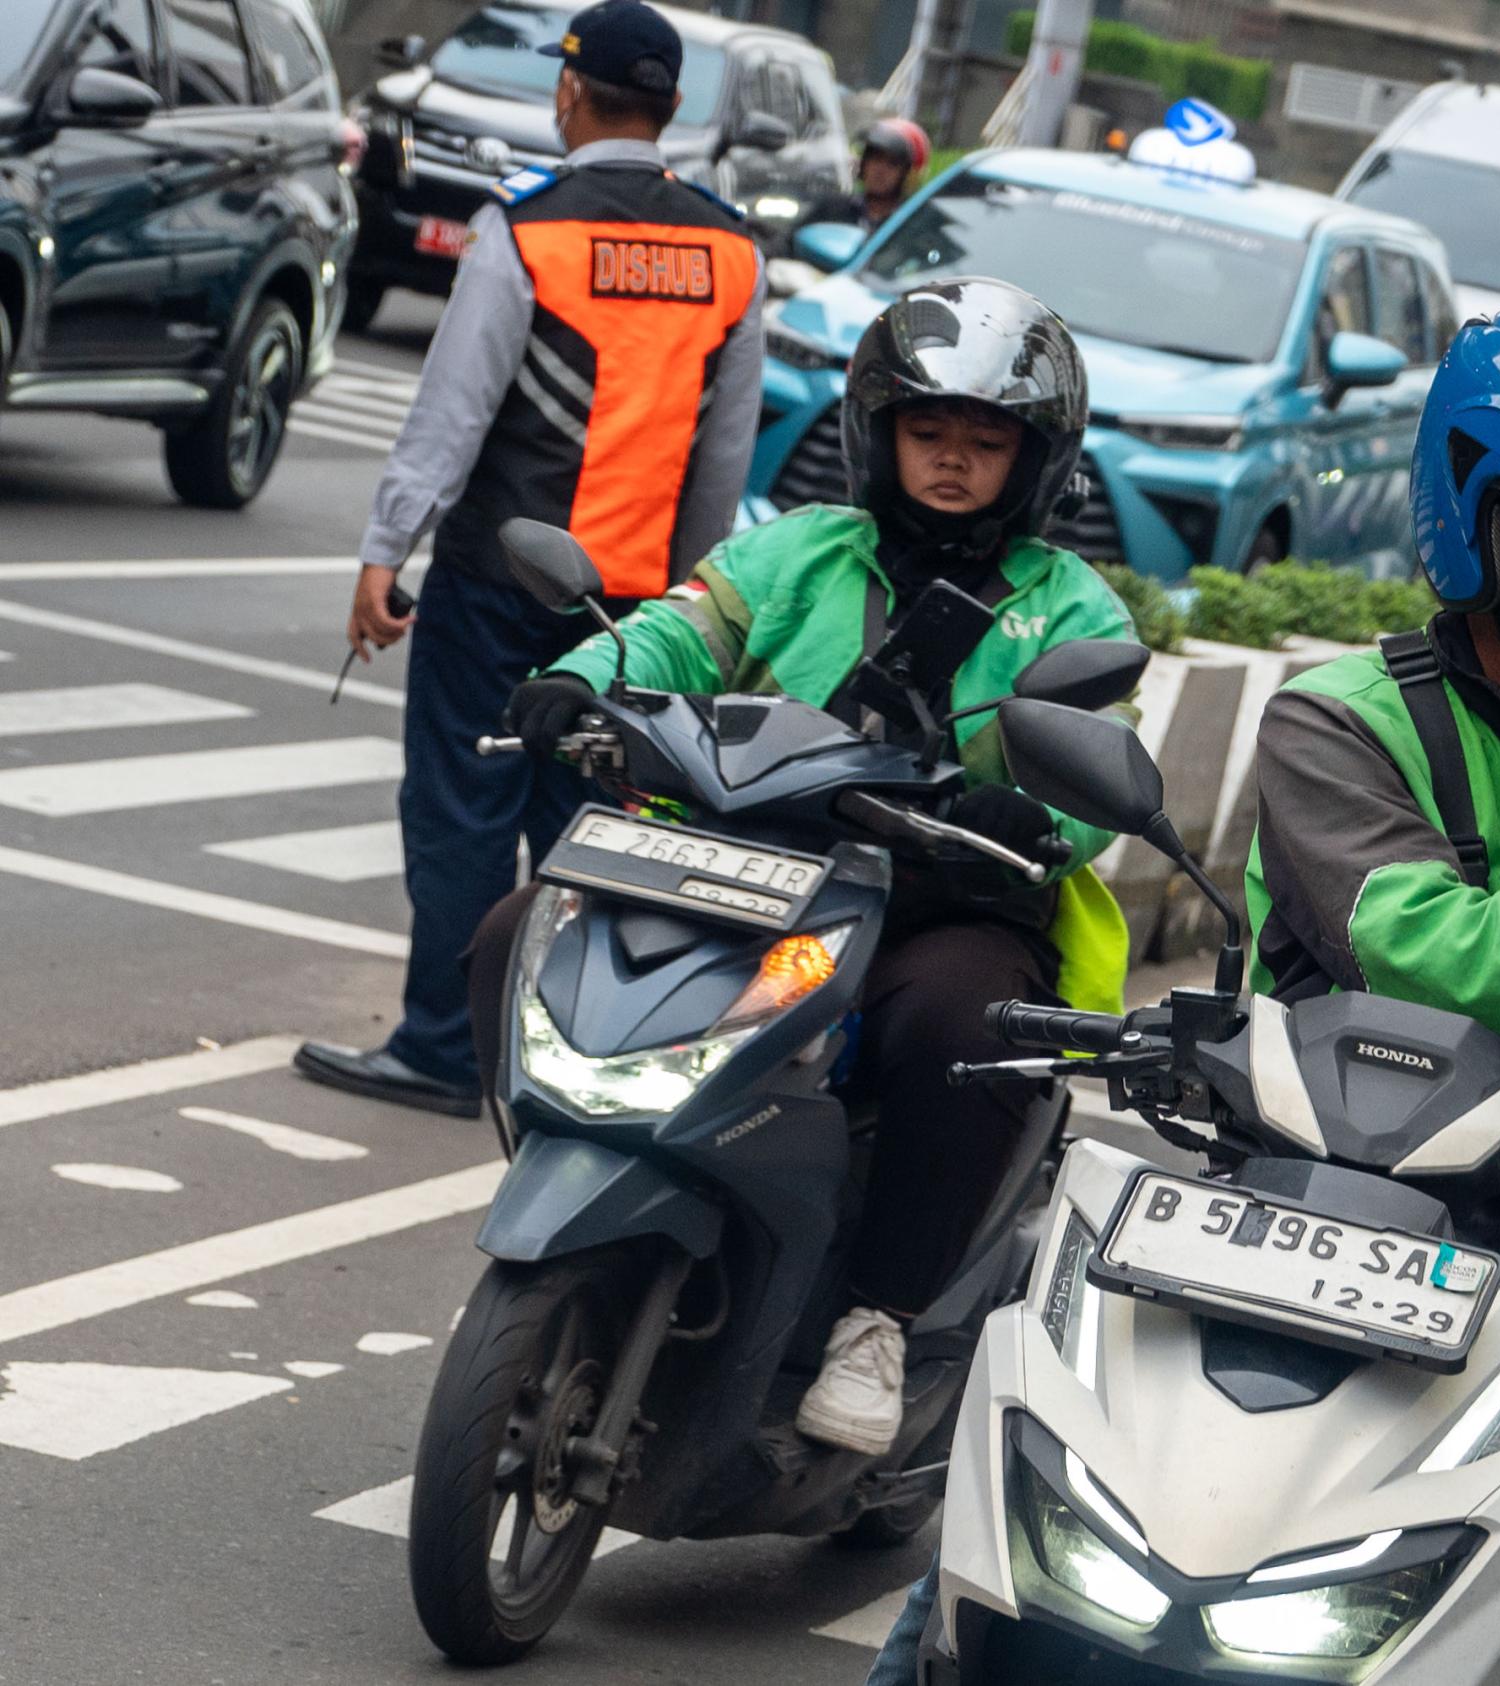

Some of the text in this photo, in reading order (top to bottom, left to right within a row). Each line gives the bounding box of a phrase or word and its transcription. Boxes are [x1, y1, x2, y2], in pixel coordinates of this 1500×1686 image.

[593, 240, 712, 298] DISHUB
[624, 832, 720, 870] 2663
[1357, 1043, 1434, 1071] HONDA
[716, 1103, 782, 1147] HONDA
[1144, 1186, 1429, 1286] B 596 SA
